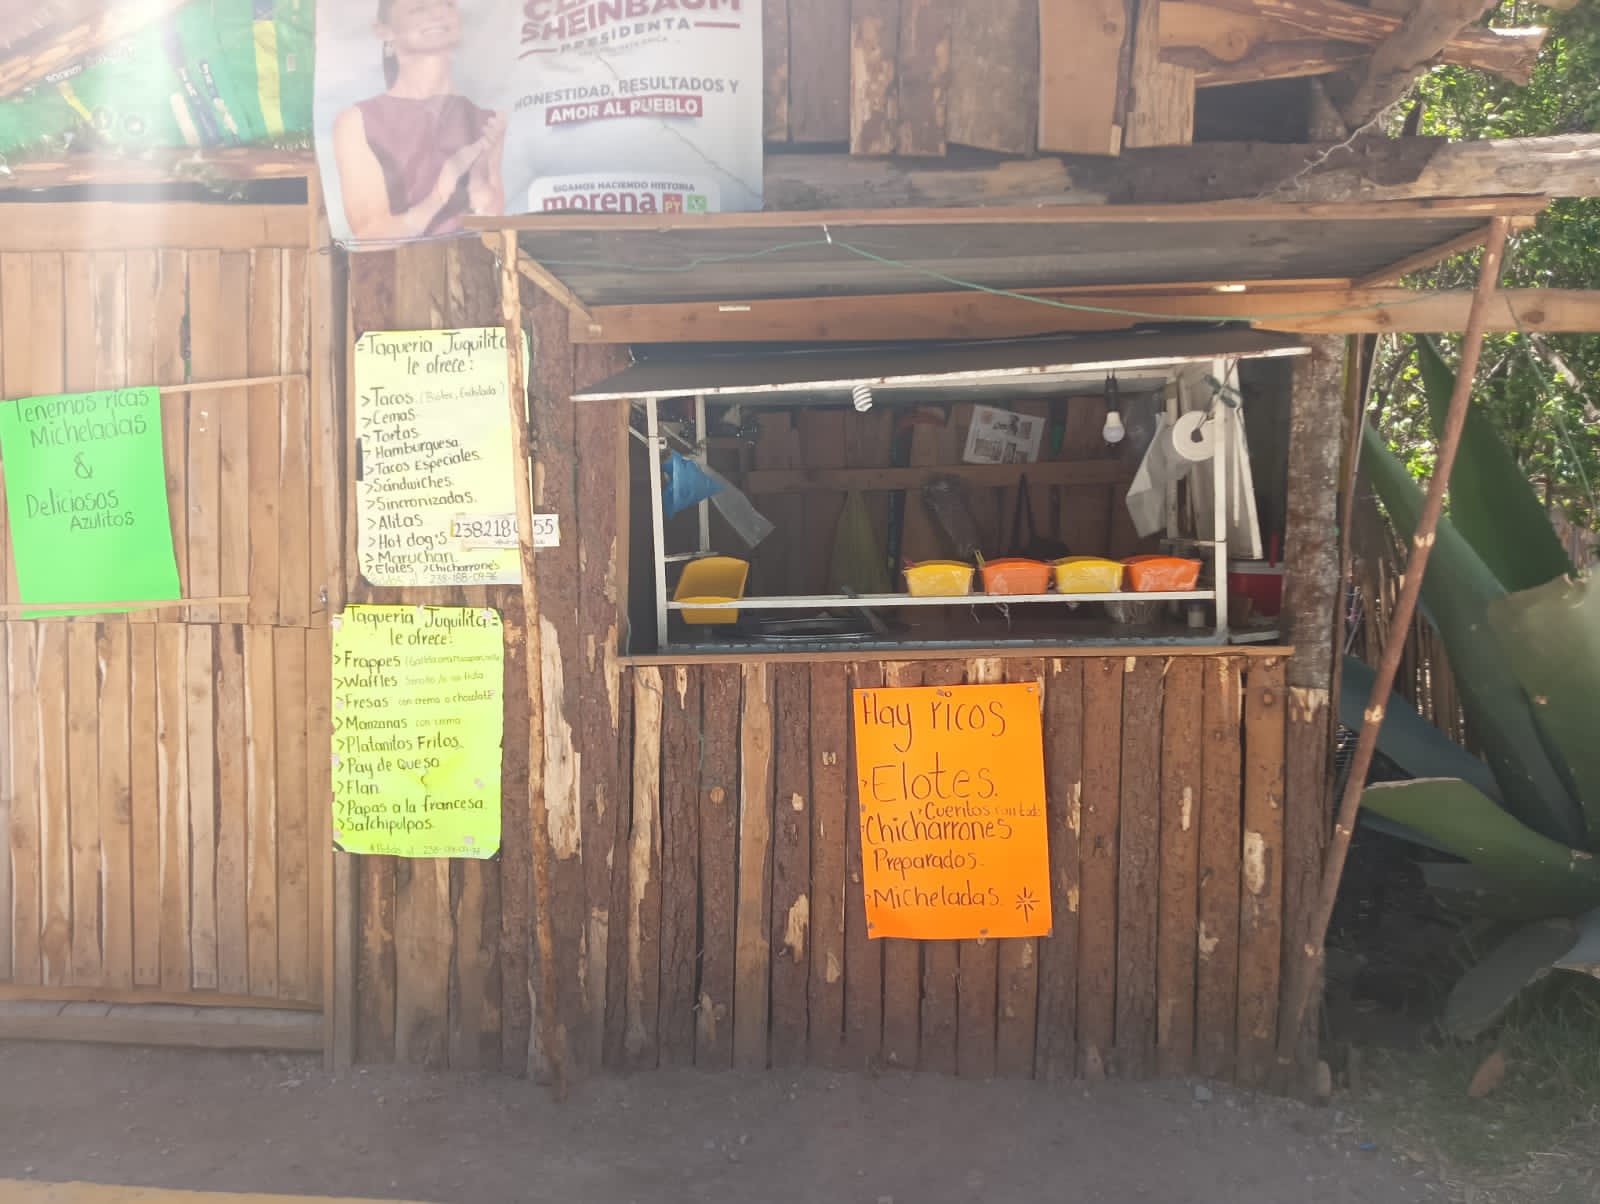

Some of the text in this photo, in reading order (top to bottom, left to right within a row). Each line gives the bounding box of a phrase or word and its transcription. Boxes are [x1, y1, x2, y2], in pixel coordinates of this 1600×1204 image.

[561, 17, 691, 52] PRESIDENTA
[619, 76, 725, 95] RESULTADOS
[729, 79, 739, 94] Y
[550, 97, 698, 124] AMOR AL PUEBLO
[553, 181, 695, 193] SIGAMOS HACIENDO HISTORIA
[542, 191, 658, 214] morena
[365, 334, 433, 361] Taqueria
[16, 388, 150, 423] Tenemos ricas
[370, 386, 414, 407] Tacos
[29, 410, 147, 449] Micheladas
[73, 451, 93, 480] &
[376, 462, 410, 475] Tacos
[26, 487, 119, 519] Deliciosos
[70, 509, 135, 533] Azulitos
[378, 513, 424, 531] Alitas
[378, 535, 403, 549] Hot
[375, 562, 414, 574] Elotes
[346, 605, 487, 634] Taqueria Juquilita
[390, 628, 403, 646] le
[344, 651, 401, 674] Frappes
[344, 675, 398, 688] Waffles
[345, 693, 389, 709] Fresas
[345, 715, 408, 731] Manzanas
[863, 691, 1006, 752] Hay ricos
[346, 735, 413, 754] Platanitos
[347, 757, 440, 780] Pay de Queso
[346, 780, 380, 795] Flan
[347, 800, 388, 819] Papas
[392, 803, 401, 813] a
[405, 798, 416, 813] la
[866, 810, 1013, 845] Chicharrones
